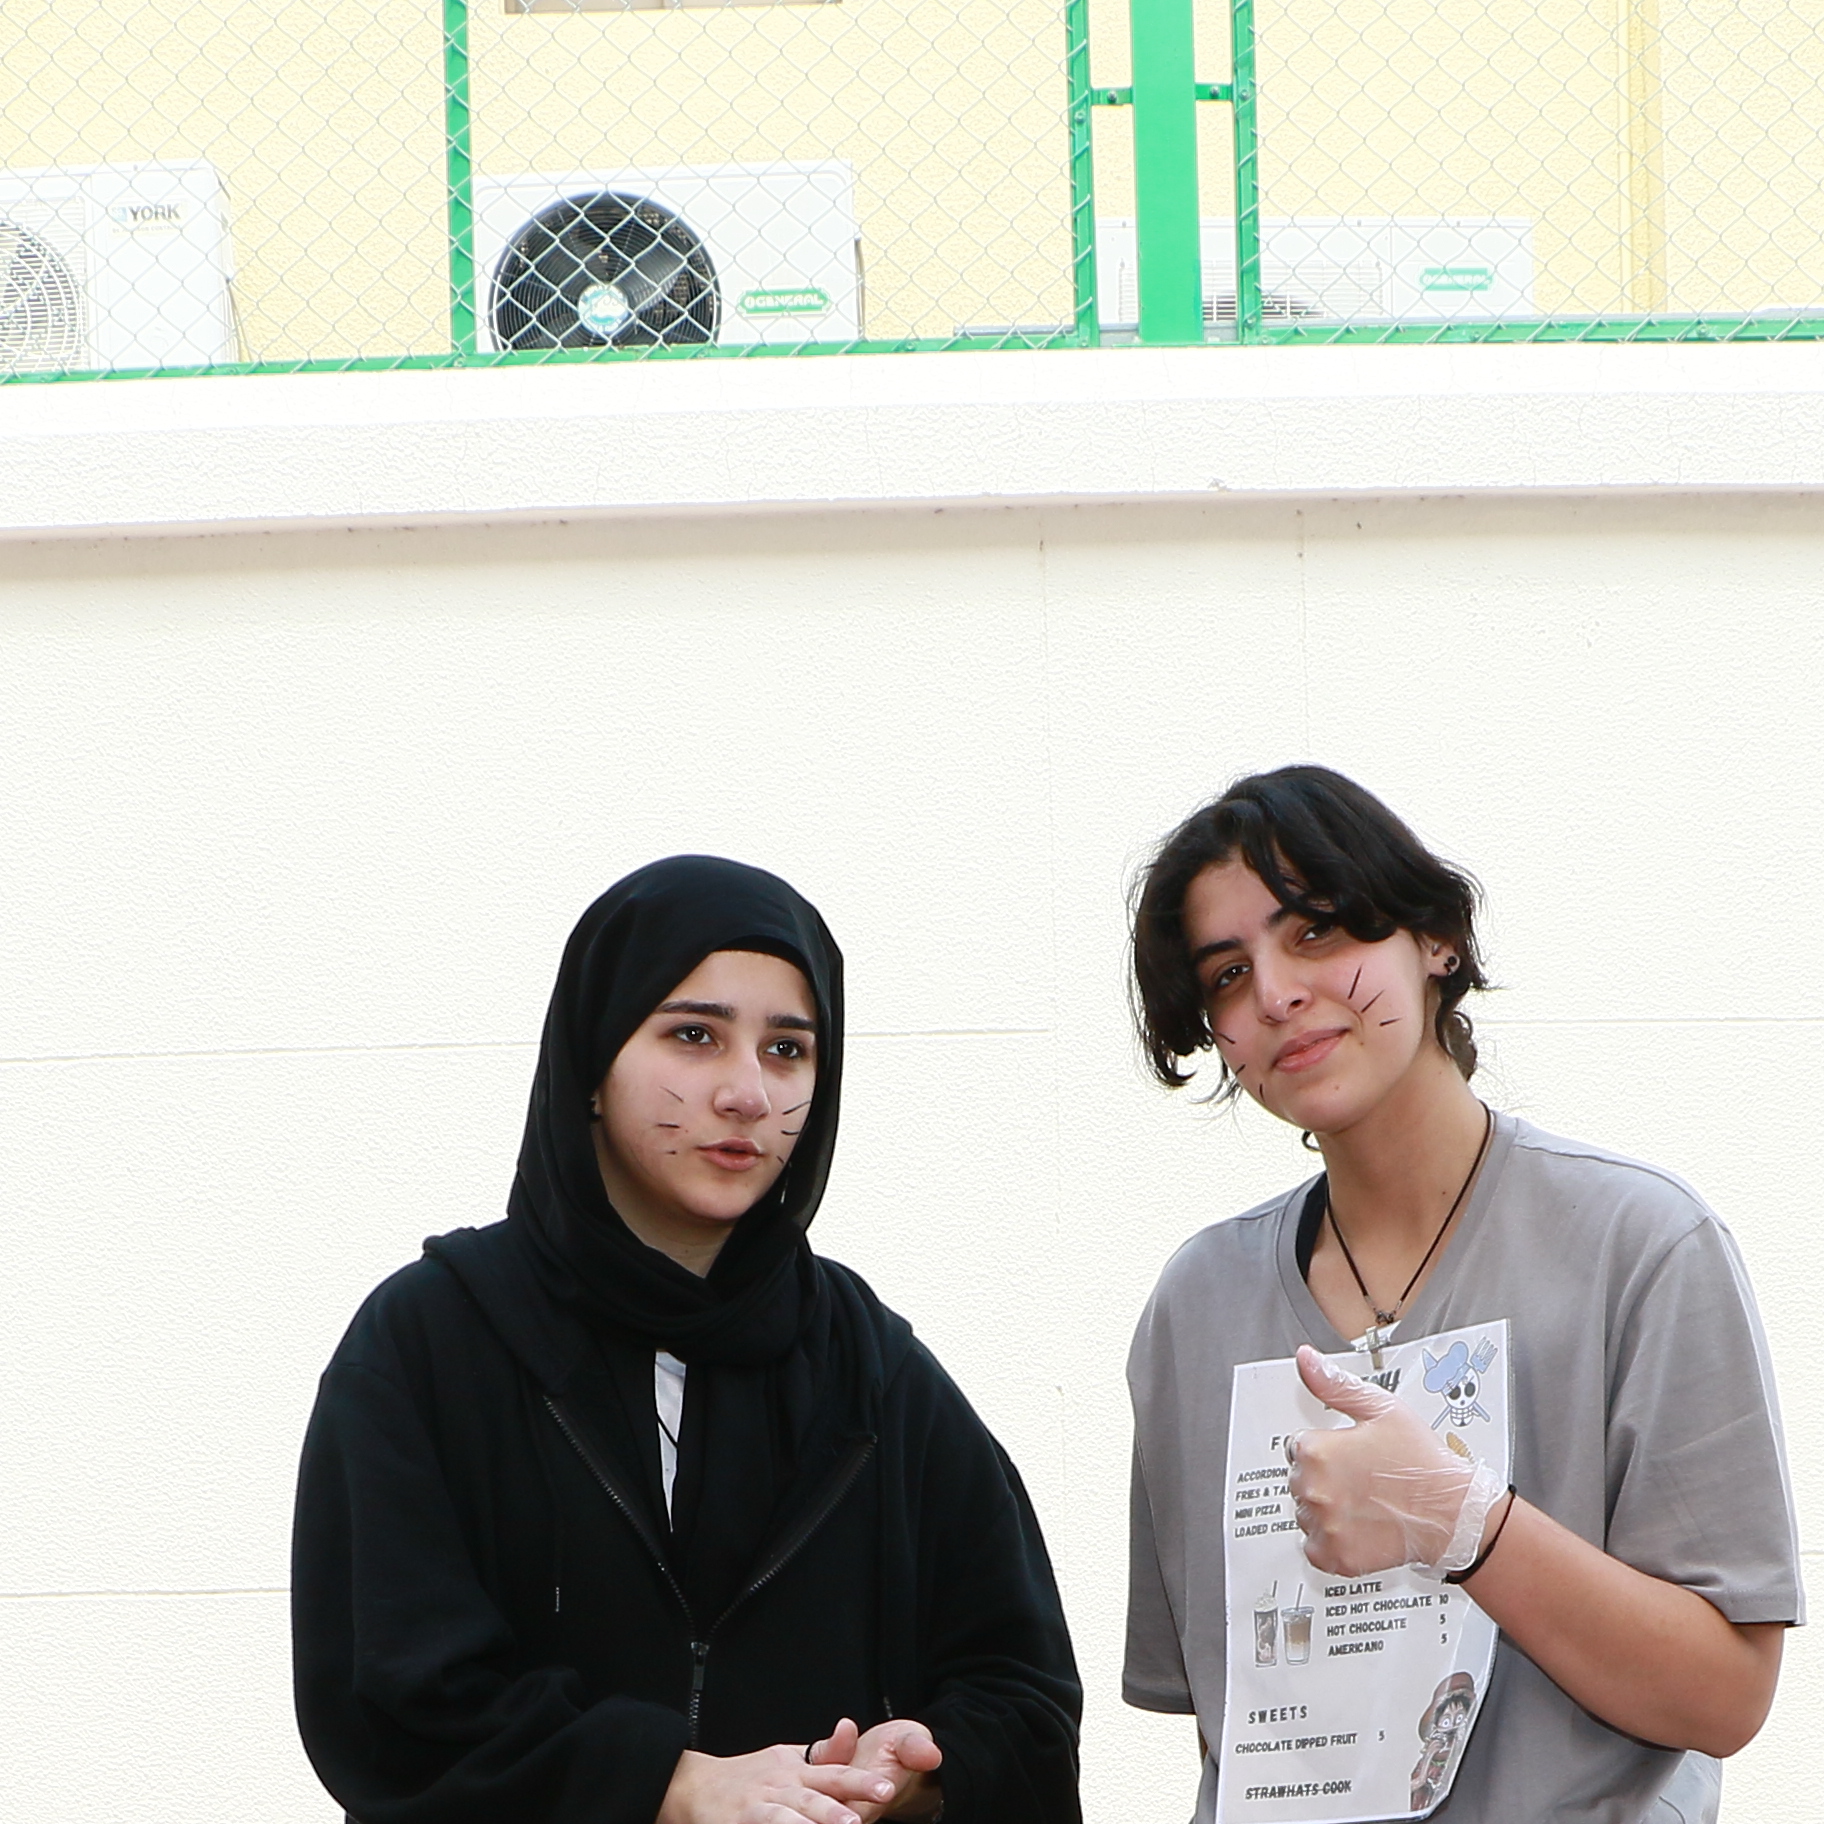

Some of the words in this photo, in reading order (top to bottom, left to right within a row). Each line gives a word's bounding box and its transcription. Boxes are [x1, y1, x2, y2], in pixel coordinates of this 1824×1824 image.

[128, 203, 181, 221] YORK
[1237, 1467, 1288, 1484] ACCORDION
[1235, 1488, 1260, 1502] FRIES
[1263, 1486, 1270, 1498] &
[1235, 1506, 1253, 1519] MINI
[1255, 1504, 1281, 1518] PIZZA
[1234, 1523, 1268, 1538] LOADED
[1325, 1585, 1347, 1598] ICED
[1349, 1581, 1382, 1595] LATTE
[1326, 1605, 1347, 1617] ICED
[1350, 1602, 1370, 1615] HOT
[1373, 1595, 1432, 1612] CHOCOLATE
[1439, 1594, 1449, 1605] 10
[1327, 1624, 1346, 1637] HOT
[1349, 1618, 1407, 1634] CHOCOLATE
[1439, 1613, 1446, 1625] 5
[1328, 1640, 1384, 1656] AMERICANO
[1441, 1633, 1448, 1644] 5
[1248, 1705, 1308, 1724] SWEETS
[1235, 1739, 1293, 1754] CHOCOLATE
[1295, 1735, 1328, 1750] DIPPED
[1330, 1732, 1358, 1746] FRUIT
[1378, 1730, 1385, 1741] 5
[1246, 1783, 1319, 1800] STRAWHATS
[1322, 1780, 1352, 1795] COOK
